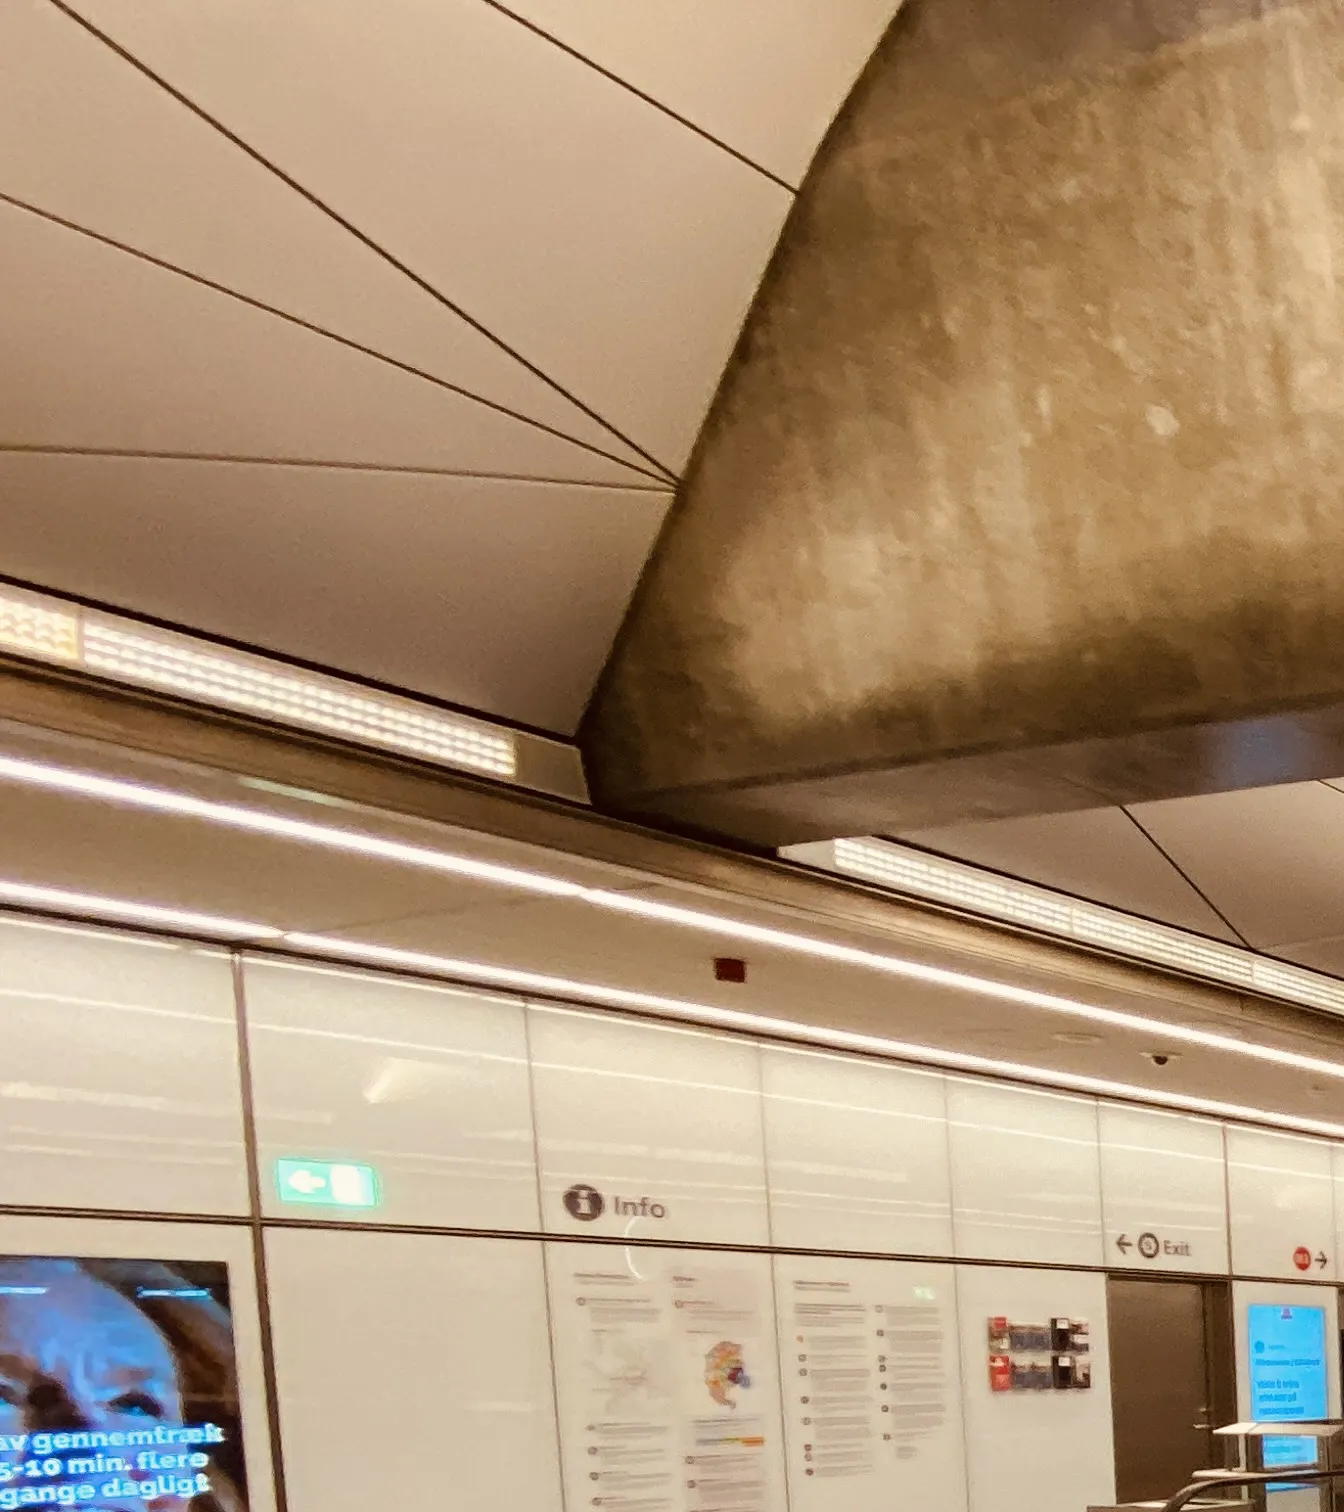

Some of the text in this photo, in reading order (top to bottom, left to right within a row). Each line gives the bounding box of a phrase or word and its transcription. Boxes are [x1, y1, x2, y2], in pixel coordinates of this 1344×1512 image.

[613, 1195, 667, 1219] Info
[1163, 1239, 1192, 1257] Exit
[32, 1422, 226, 1455] gennemtræk
[67, 1453, 133, 1474] min.
[136, 1451, 209, 1471] flere
[0, 1473, 212, 1510] gange dagligt
